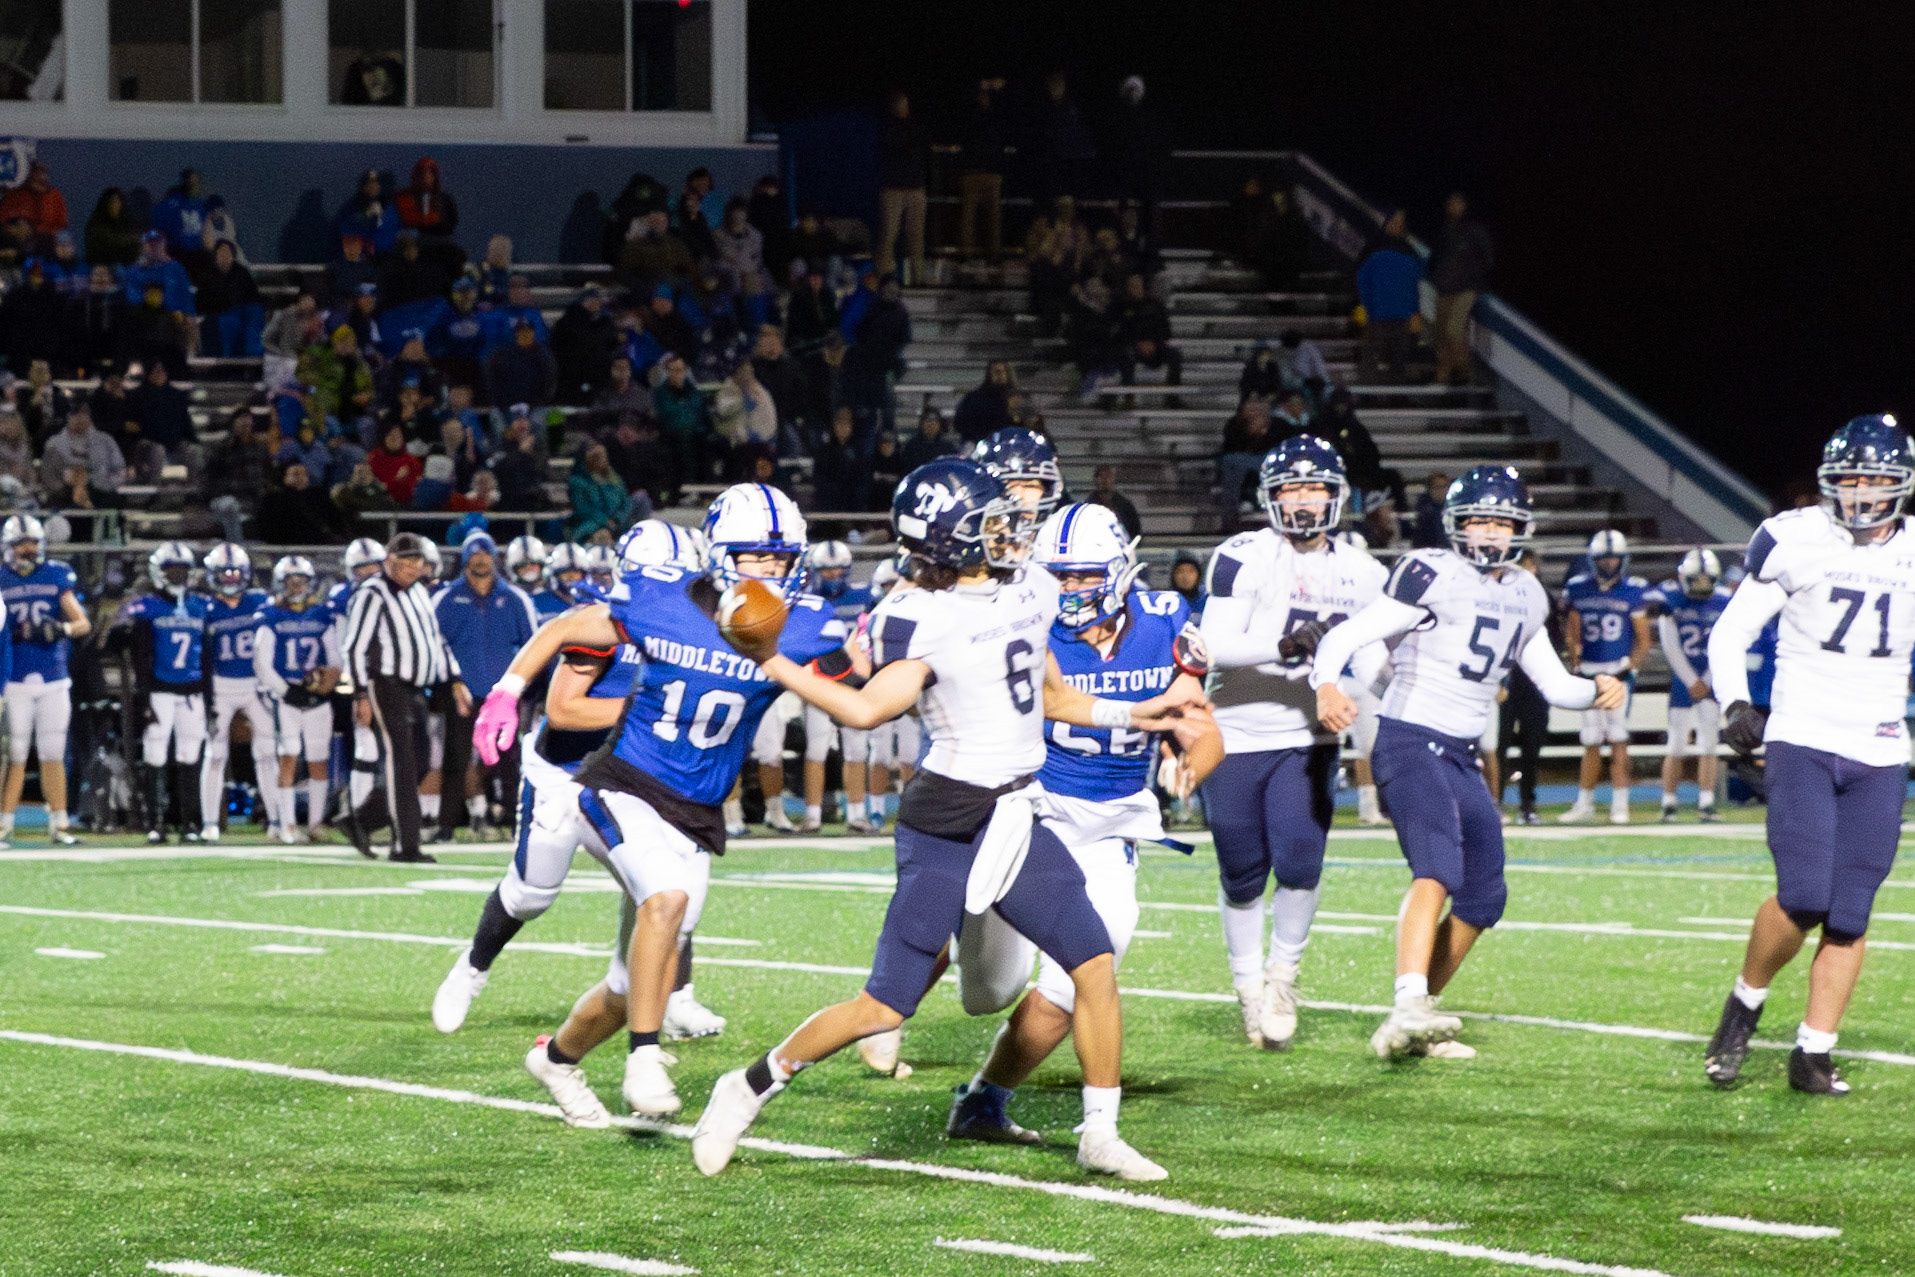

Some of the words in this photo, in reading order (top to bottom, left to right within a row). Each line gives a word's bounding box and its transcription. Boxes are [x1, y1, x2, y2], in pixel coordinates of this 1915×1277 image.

[219, 630, 255, 661] 18
[1459, 615, 1523, 682] 54
[1820, 586, 1893, 657] 71
[171, 632, 191, 669] 7
[285, 636, 320, 671] 17
[644, 635, 776, 682] MIDDLETO
[1005, 638, 1034, 715] 6
[652, 680, 747, 750] 10
